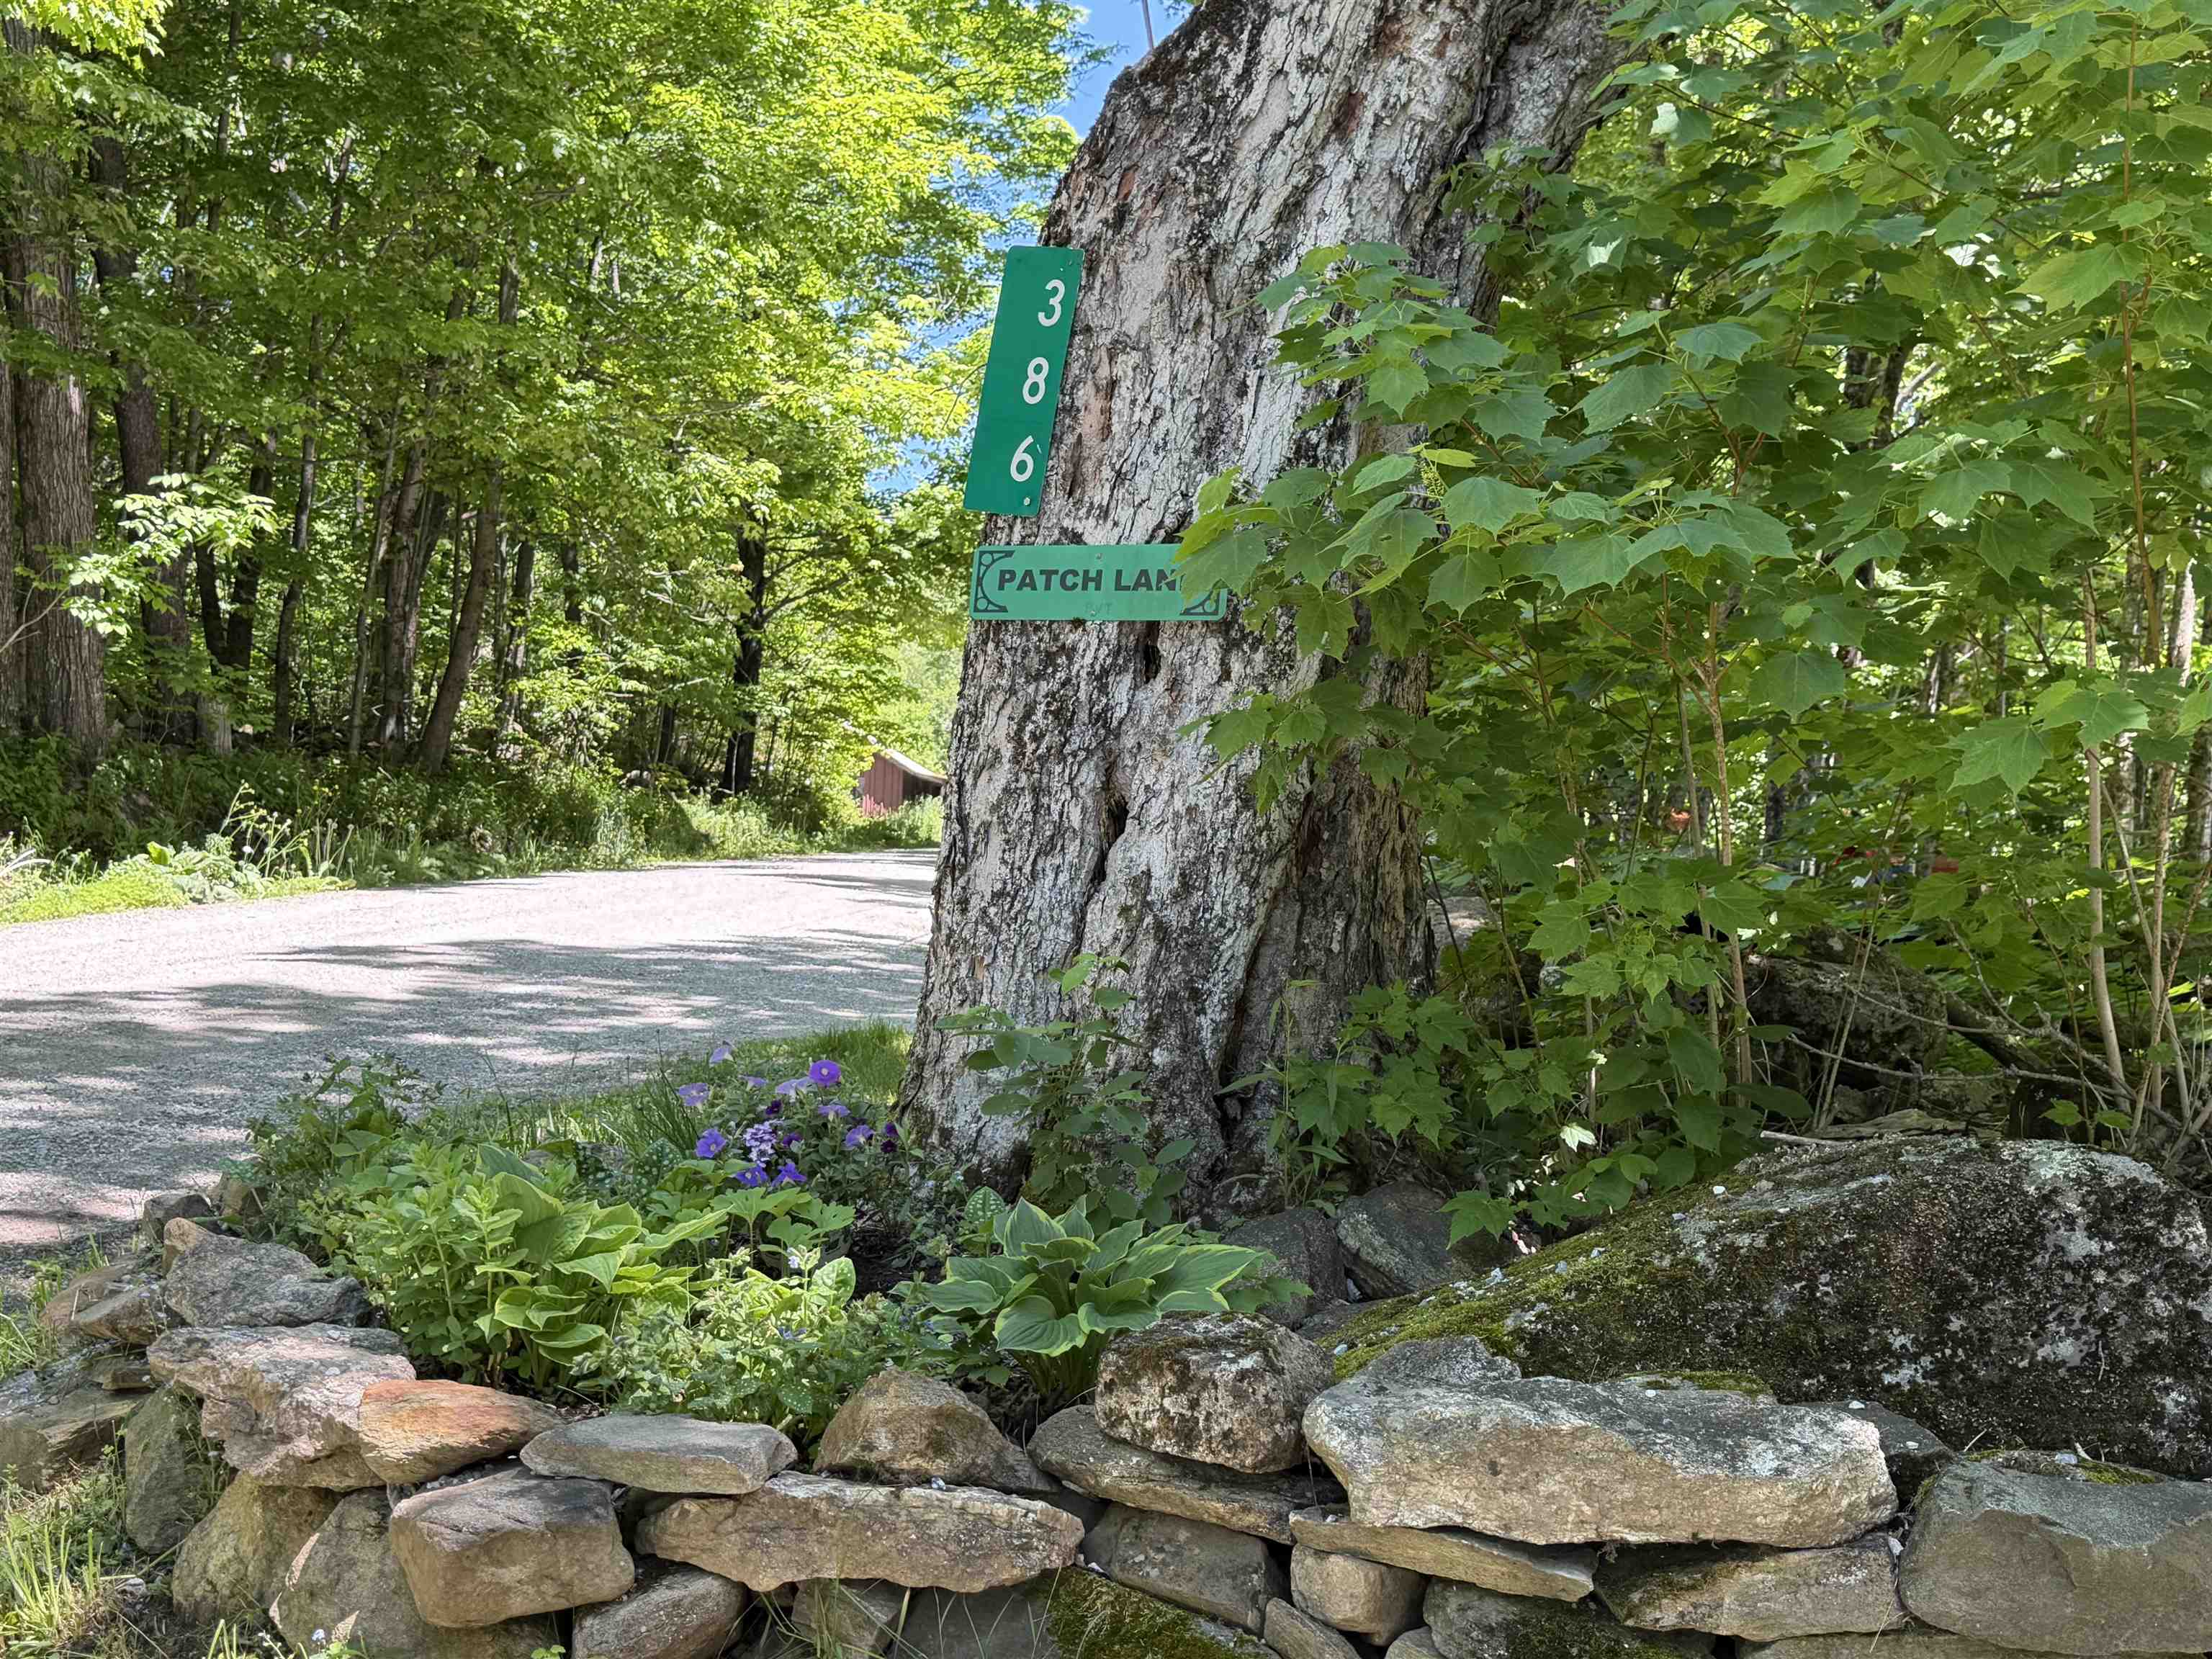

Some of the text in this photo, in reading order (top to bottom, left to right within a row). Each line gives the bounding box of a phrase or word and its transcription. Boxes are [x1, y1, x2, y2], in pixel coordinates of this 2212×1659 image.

[1010, 279, 1065, 482] 386
[997, 568, 1185, 591] PATCH LAN
